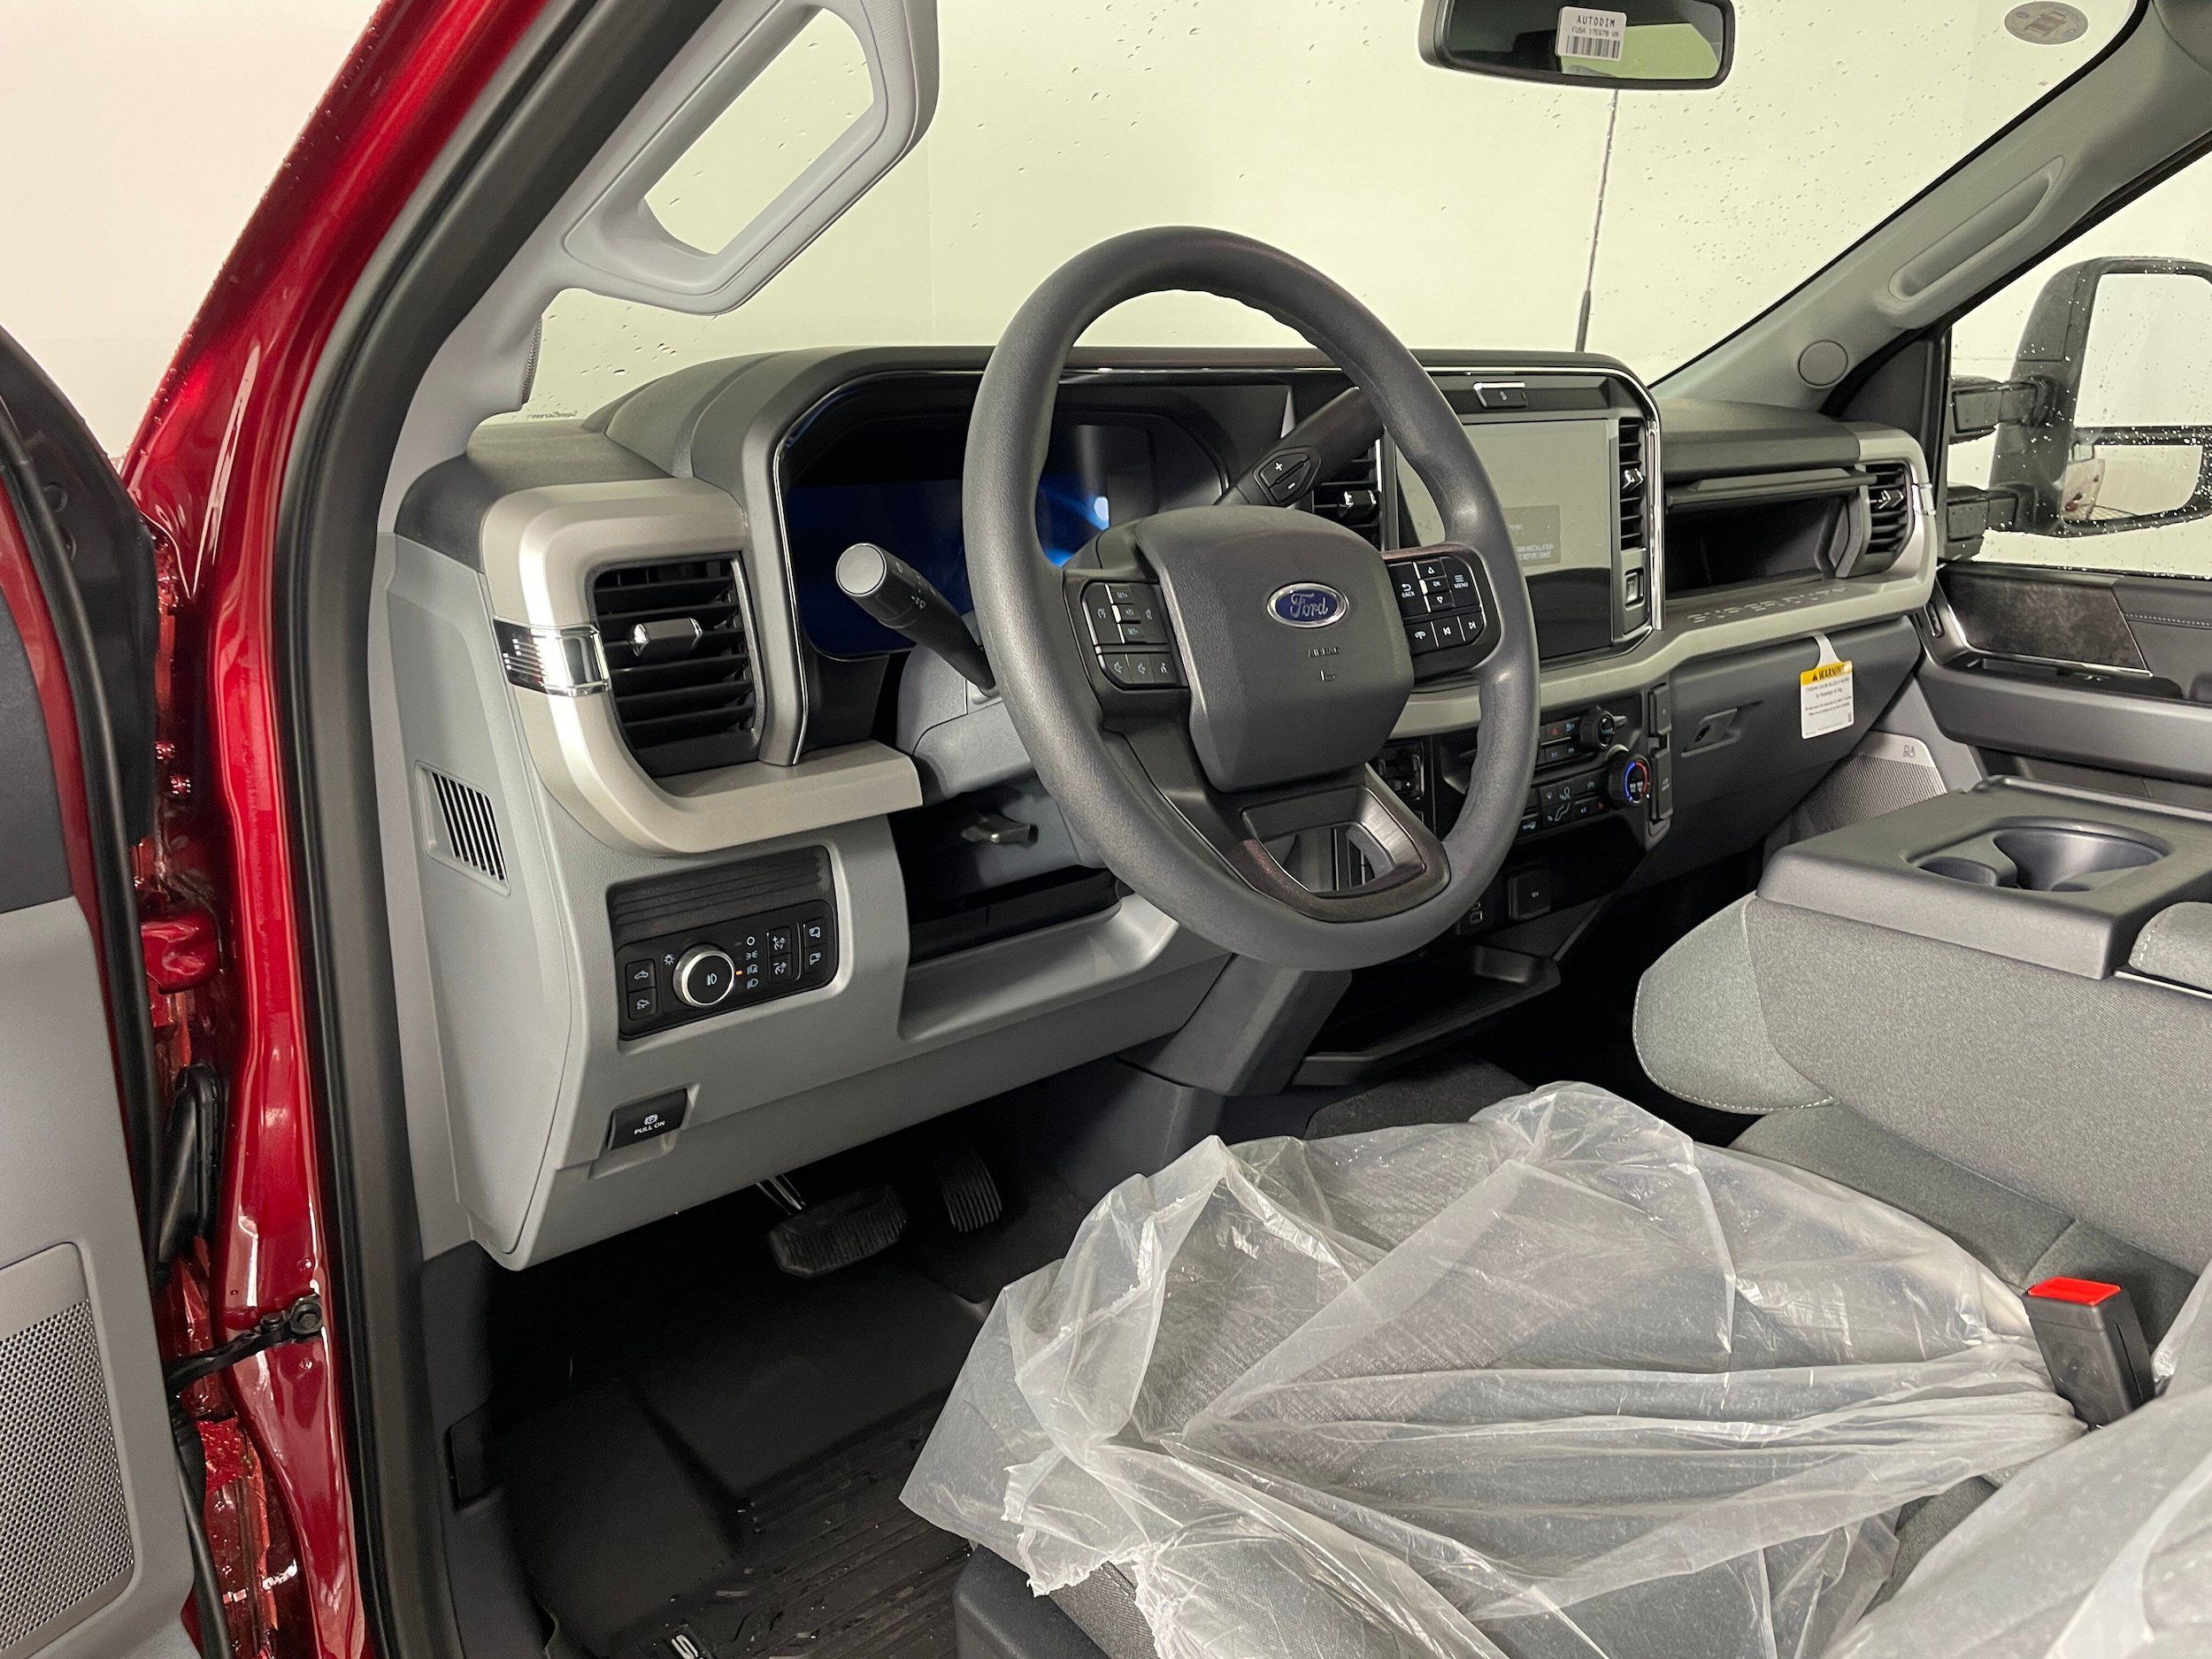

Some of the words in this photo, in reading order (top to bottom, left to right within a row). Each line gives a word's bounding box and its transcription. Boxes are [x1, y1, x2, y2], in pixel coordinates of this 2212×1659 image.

[1576, 14, 1616, 27] AUTODIM
[1401, 590, 1416, 599] BACK
[1289, 592, 1329, 618] Ford
[634, 1125, 654, 1135] PULL
[654, 1120, 665, 1129] ON
